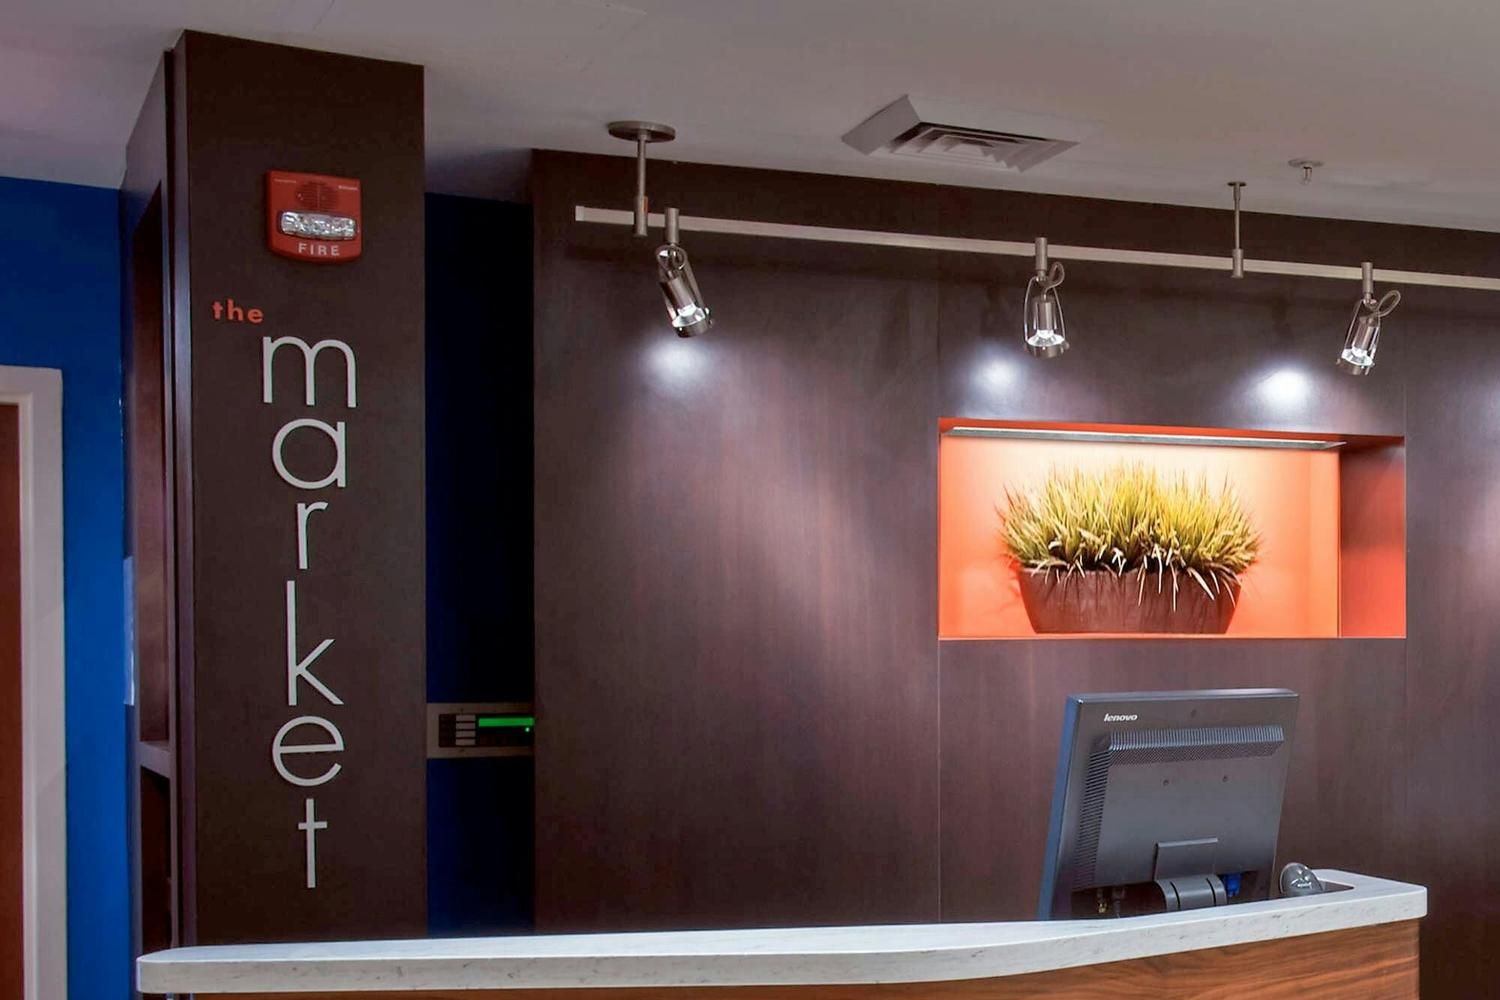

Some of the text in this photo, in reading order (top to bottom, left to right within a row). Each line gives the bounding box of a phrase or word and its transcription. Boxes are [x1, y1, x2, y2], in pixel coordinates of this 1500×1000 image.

[298, 243, 340, 256] FIRE
[211, 299, 264, 323] the
[262, 335, 357, 888] market
